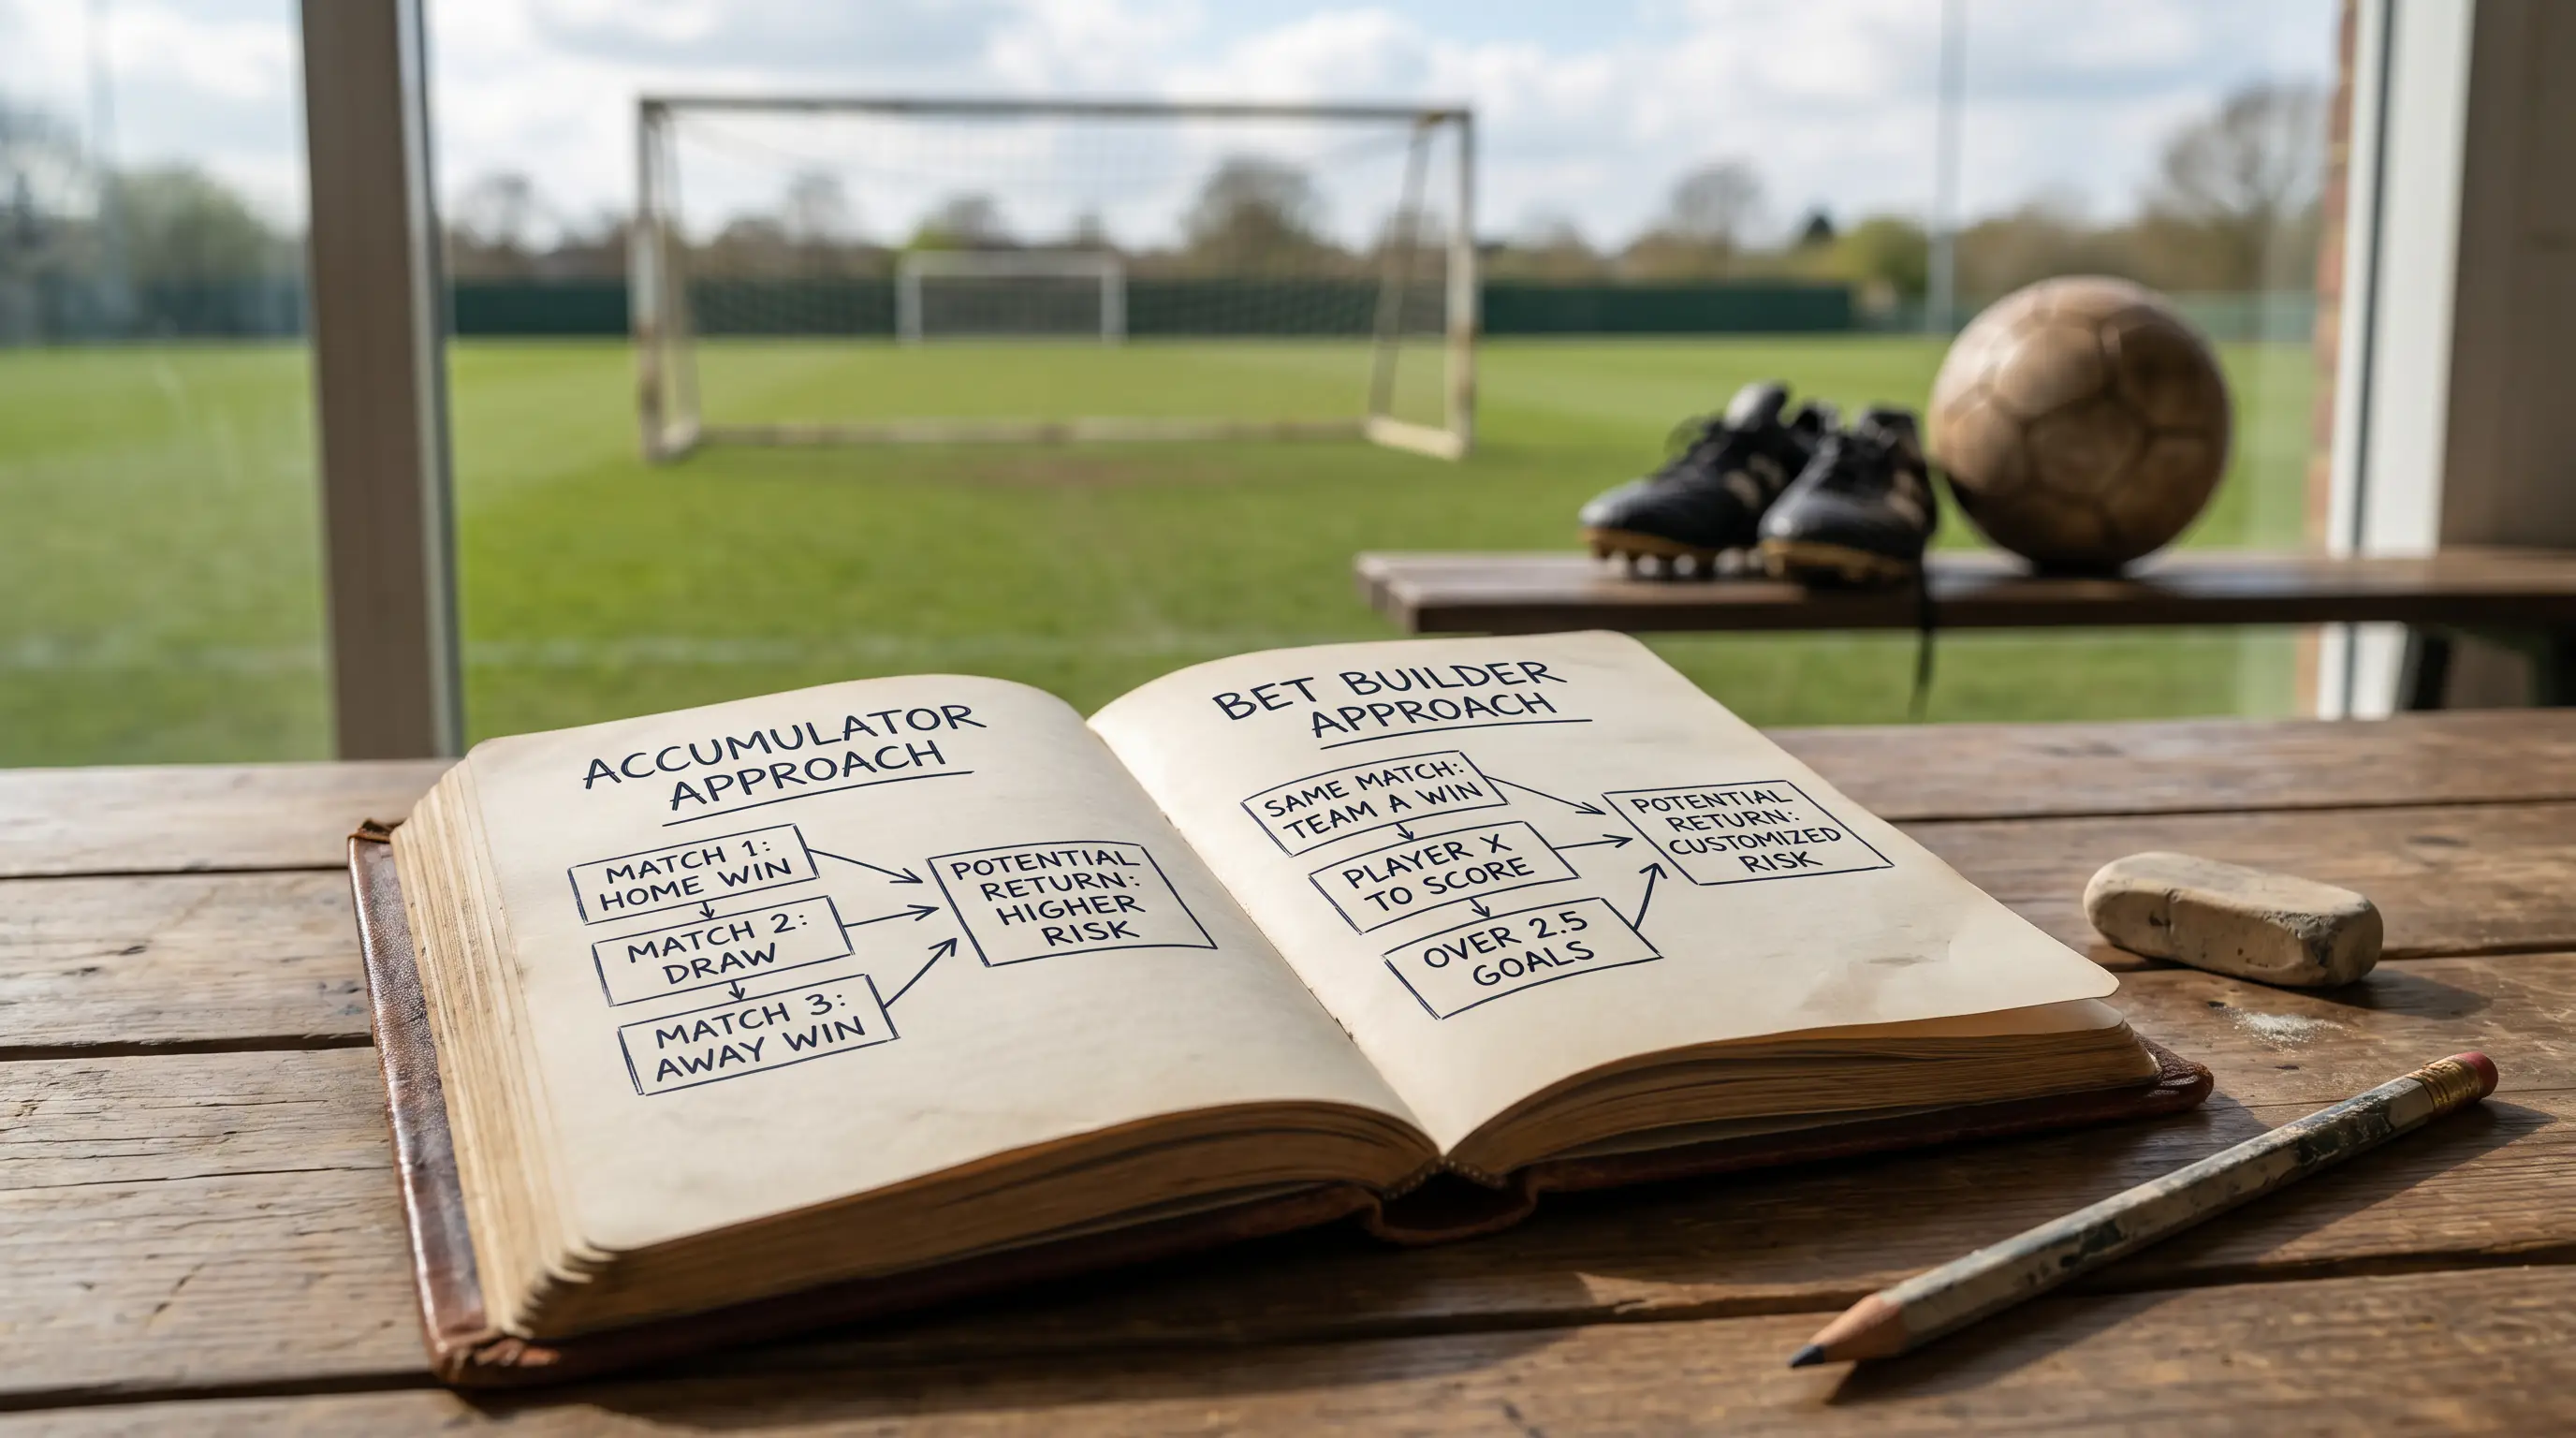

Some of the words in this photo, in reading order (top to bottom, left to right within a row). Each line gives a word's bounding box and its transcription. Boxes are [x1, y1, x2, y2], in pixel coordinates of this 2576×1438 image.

[1211, 676, 1318, 721] BET
[1339, 661, 1568, 697] BUILDER
[1310, 692, 1558, 739] APPROACH
[582, 704, 988, 790] ACCUMULATOR
[669, 739, 946, 812] APPROACH
[1264, 780, 1351, 818] SAME
[1354, 760, 1465, 791] MATCH:
[1282, 800, 1379, 839] TEAM
[1388, 793, 1412, 814] A
[1414, 781, 1484, 806] WIN
[1630, 789, 1793, 814] POTENTIAL
[1664, 809, 1800, 833] RETURN:
[606, 845, 726, 885] MATCH
[741, 840, 771, 858] 1:
[949, 849, 1141, 881] POTENTIAL
[1341, 841, 1474, 889] PLAYER
[1478, 833, 1513, 854] X
[1668, 827, 1842, 856] CUSTOMIZED
[1737, 850, 1823, 873] RISK
[599, 874, 705, 912] HOME
[716, 857, 792, 888] WIN
[979, 872, 1141, 902] RETURN:
[1363, 886, 1413, 912] TO
[1422, 856, 1535, 895] SCORE
[995, 894, 1147, 927] HIGHER
[1040, 919, 1141, 947] RISK
[627, 920, 755, 964] MATCH
[769, 913, 808, 934] 2:
[1423, 926, 1523, 969] OVER
[1528, 910, 1588, 939] 2.5
[662, 942, 776, 985] DRAW
[1472, 940, 1595, 987] GOALS
[655, 1002, 791, 1049] MATCH
[804, 993, 846, 1016] 3:
[656, 1035, 766, 1083] AWAY
[782, 1015, 866, 1052] WIN
